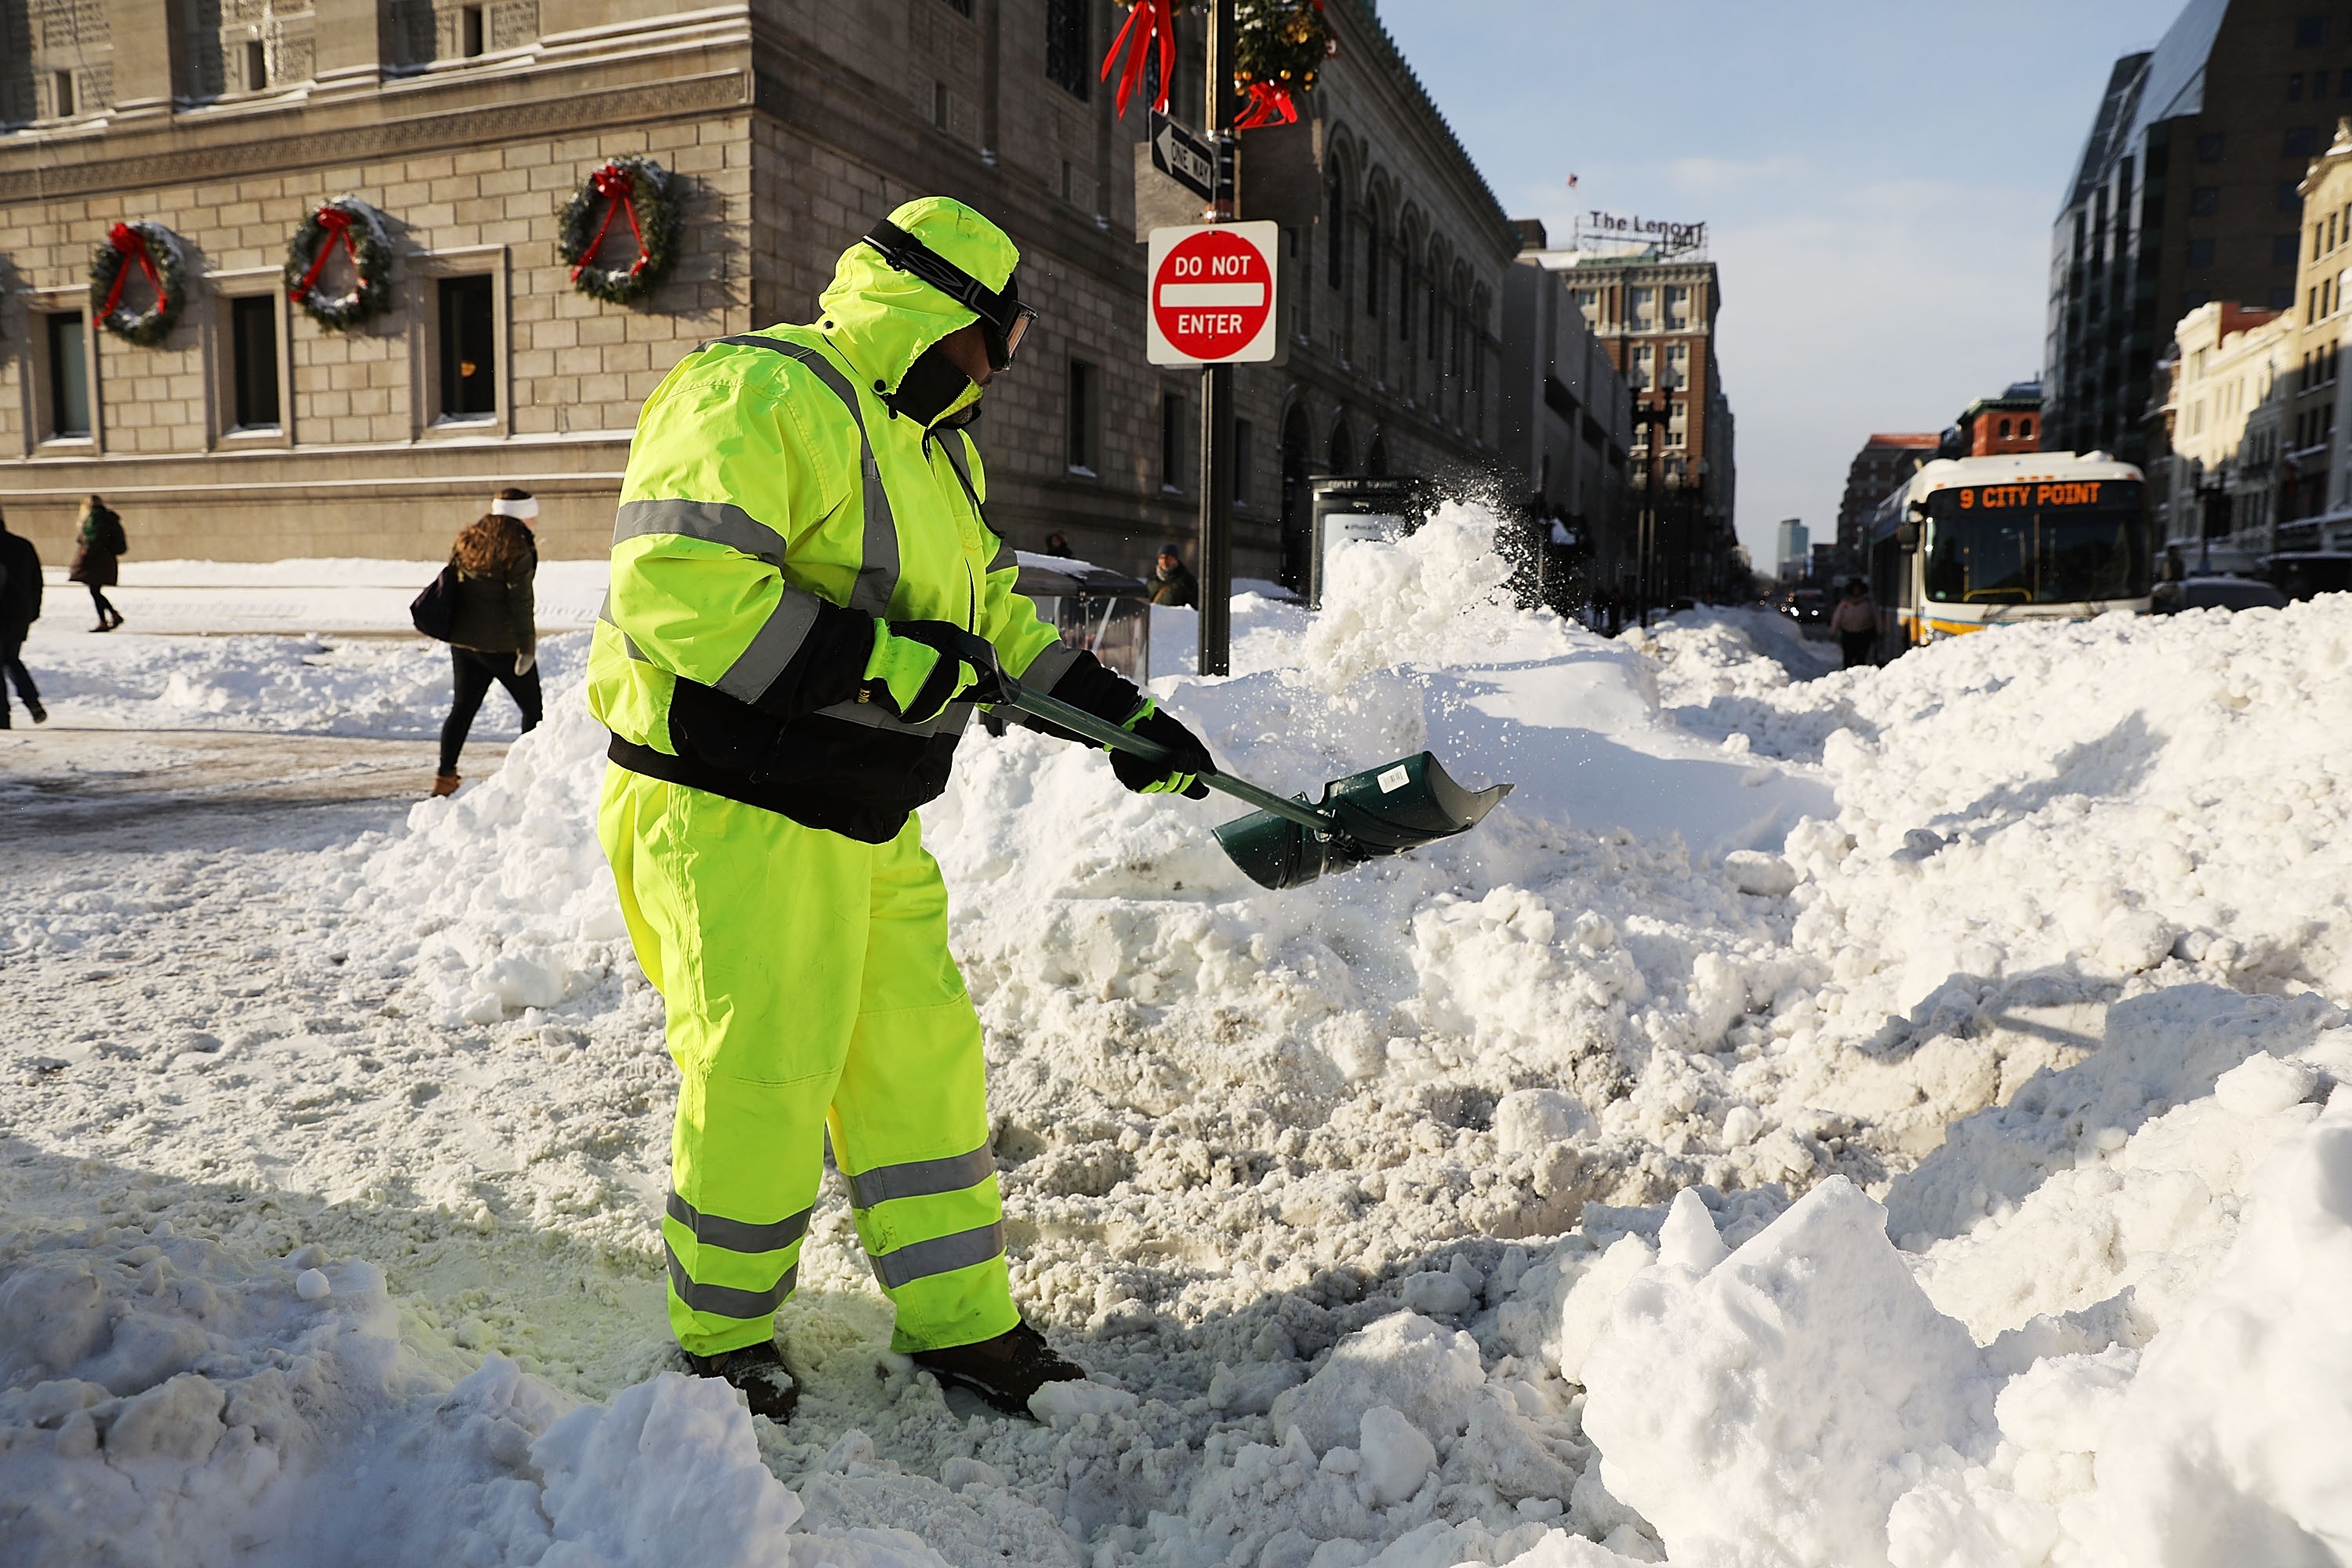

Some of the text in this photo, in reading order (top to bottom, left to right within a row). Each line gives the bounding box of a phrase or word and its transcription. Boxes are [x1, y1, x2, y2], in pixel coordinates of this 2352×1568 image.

[1172, 141, 1208, 183] ONE WAY
[1590, 210, 1628, 231] The
[1175, 255, 1252, 277] DO NOT
[1178, 314, 1243, 334] ENTER
[1327, 480, 1359, 489] COPLEY
[1960, 481, 2102, 510] 9 CITY POINT
